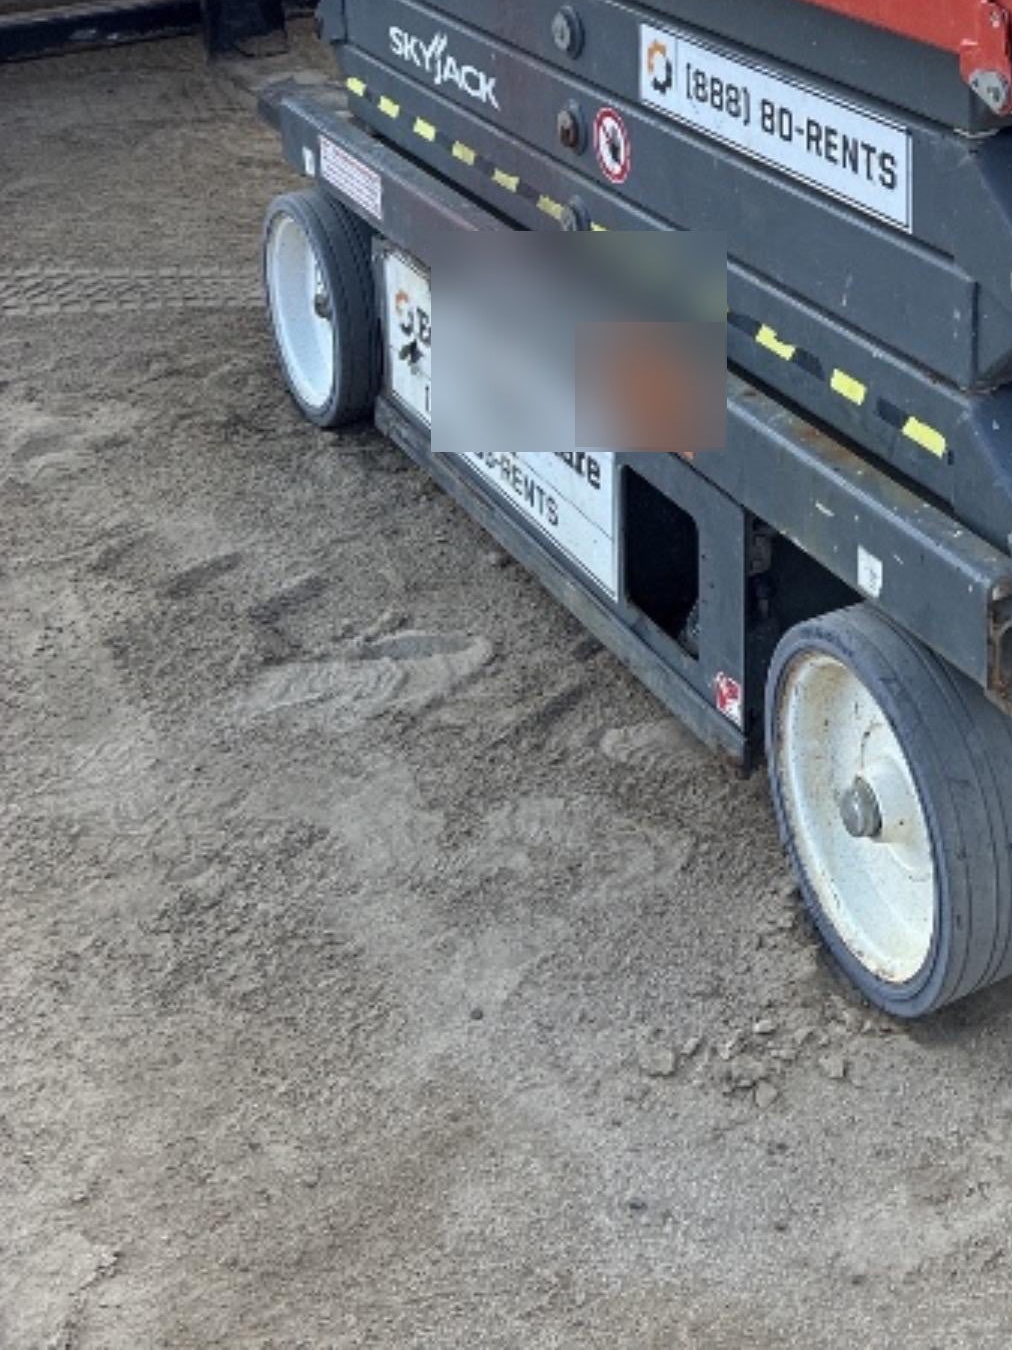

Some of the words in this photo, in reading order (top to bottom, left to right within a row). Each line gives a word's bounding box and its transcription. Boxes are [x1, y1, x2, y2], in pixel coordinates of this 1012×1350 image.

[388, 26, 500, 111] SKYJACK
[685, 62, 751, 127] (888)
[760, 98, 897, 190] 80-RENTS
[474, 452, 559, 526] 0-RENTS
